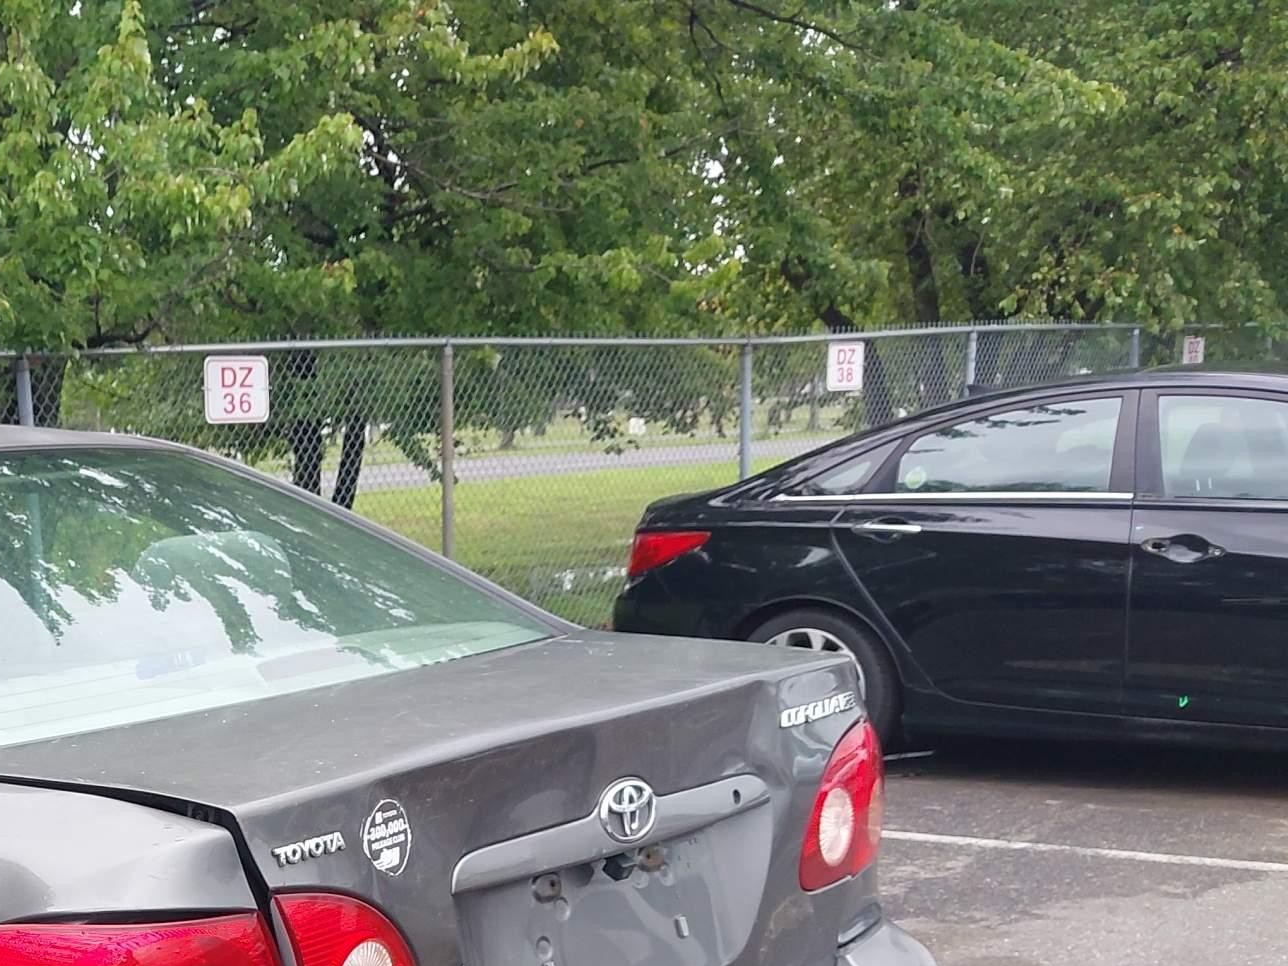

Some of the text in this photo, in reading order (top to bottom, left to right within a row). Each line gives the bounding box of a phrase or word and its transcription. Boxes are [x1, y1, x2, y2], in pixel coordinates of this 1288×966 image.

[837, 348, 856, 365] DZ
[220, 366, 254, 388] DZ
[837, 367, 854, 383] 38
[223, 392, 252, 414] 36
[272, 830, 346, 867] TOYOTA
